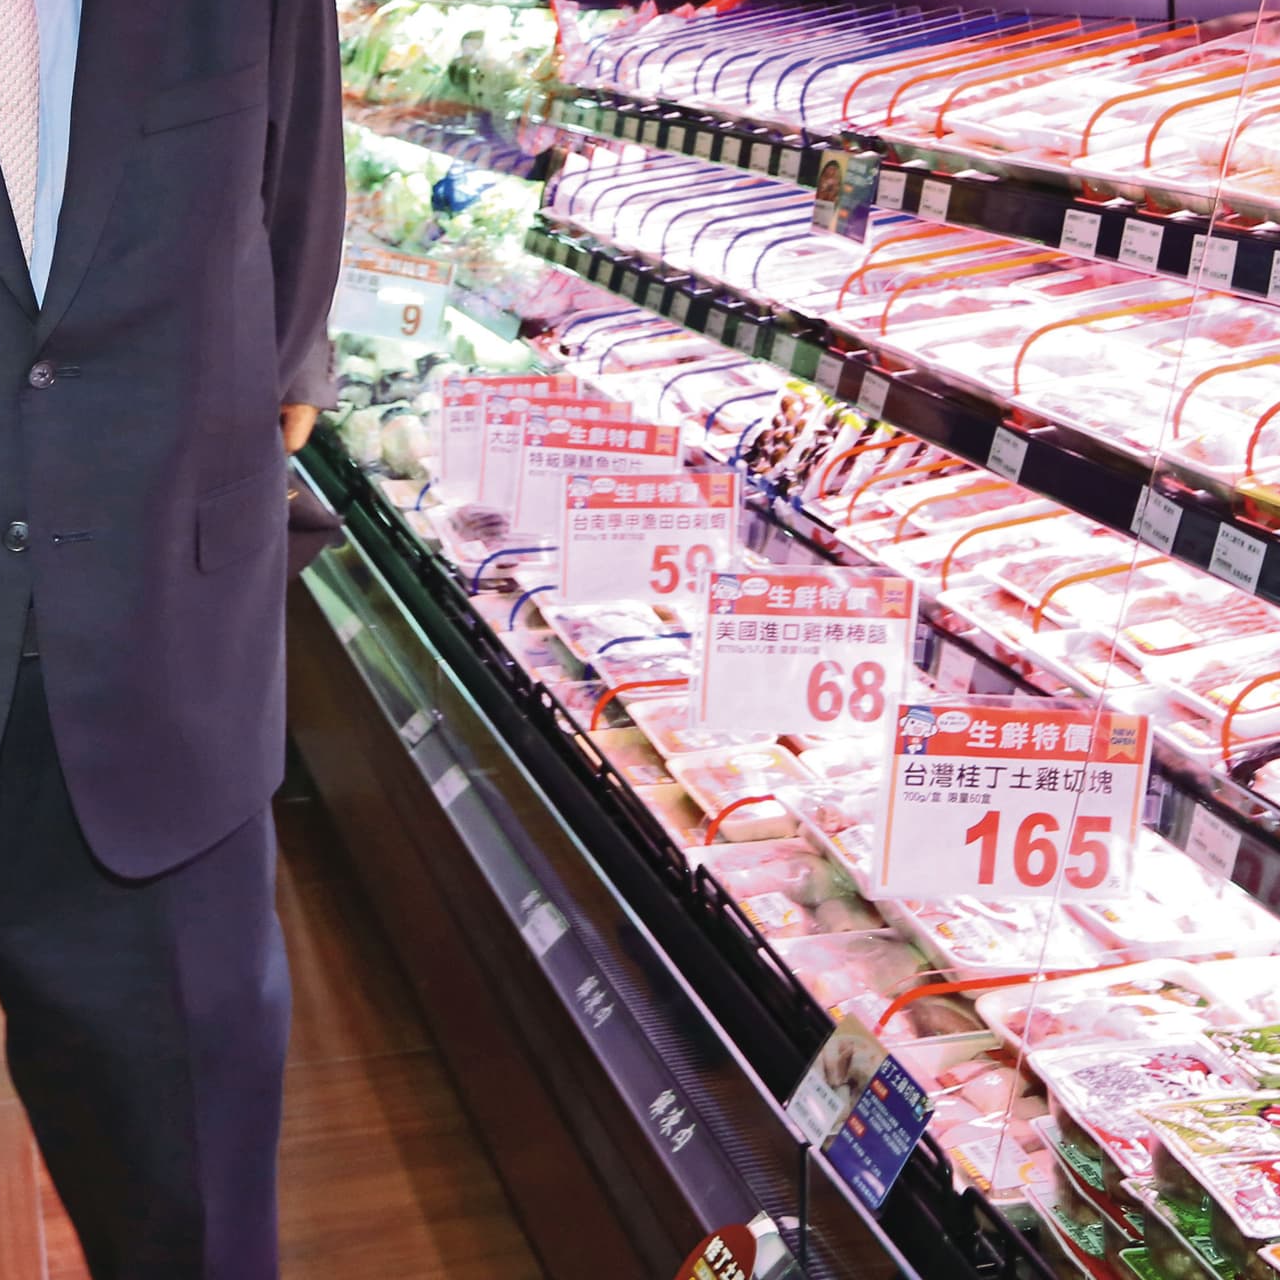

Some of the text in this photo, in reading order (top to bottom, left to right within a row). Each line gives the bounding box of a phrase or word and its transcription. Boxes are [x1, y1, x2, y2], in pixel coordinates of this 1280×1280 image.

[401, 303, 421, 336] 9
[568, 426, 647, 450] 生鮮特價
[613, 482, 700, 504] 生鮮特價
[648, 543, 716, 595] 59
[766, 583, 872, 612] 生鮮特價
[715, 619, 888, 645] 美國進口雞棒棒腿
[806, 660, 887, 723] 68
[966, 719, 1094, 753] 生鮮特價
[1110, 737, 1137, 748] OPEN
[1112, 728, 1136, 739] NEW
[903, 762, 1113, 796] 台灣桂丁土雞切塊
[965, 809, 1113, 890] 165
[647, 1089, 696, 1155] 解凍肉
